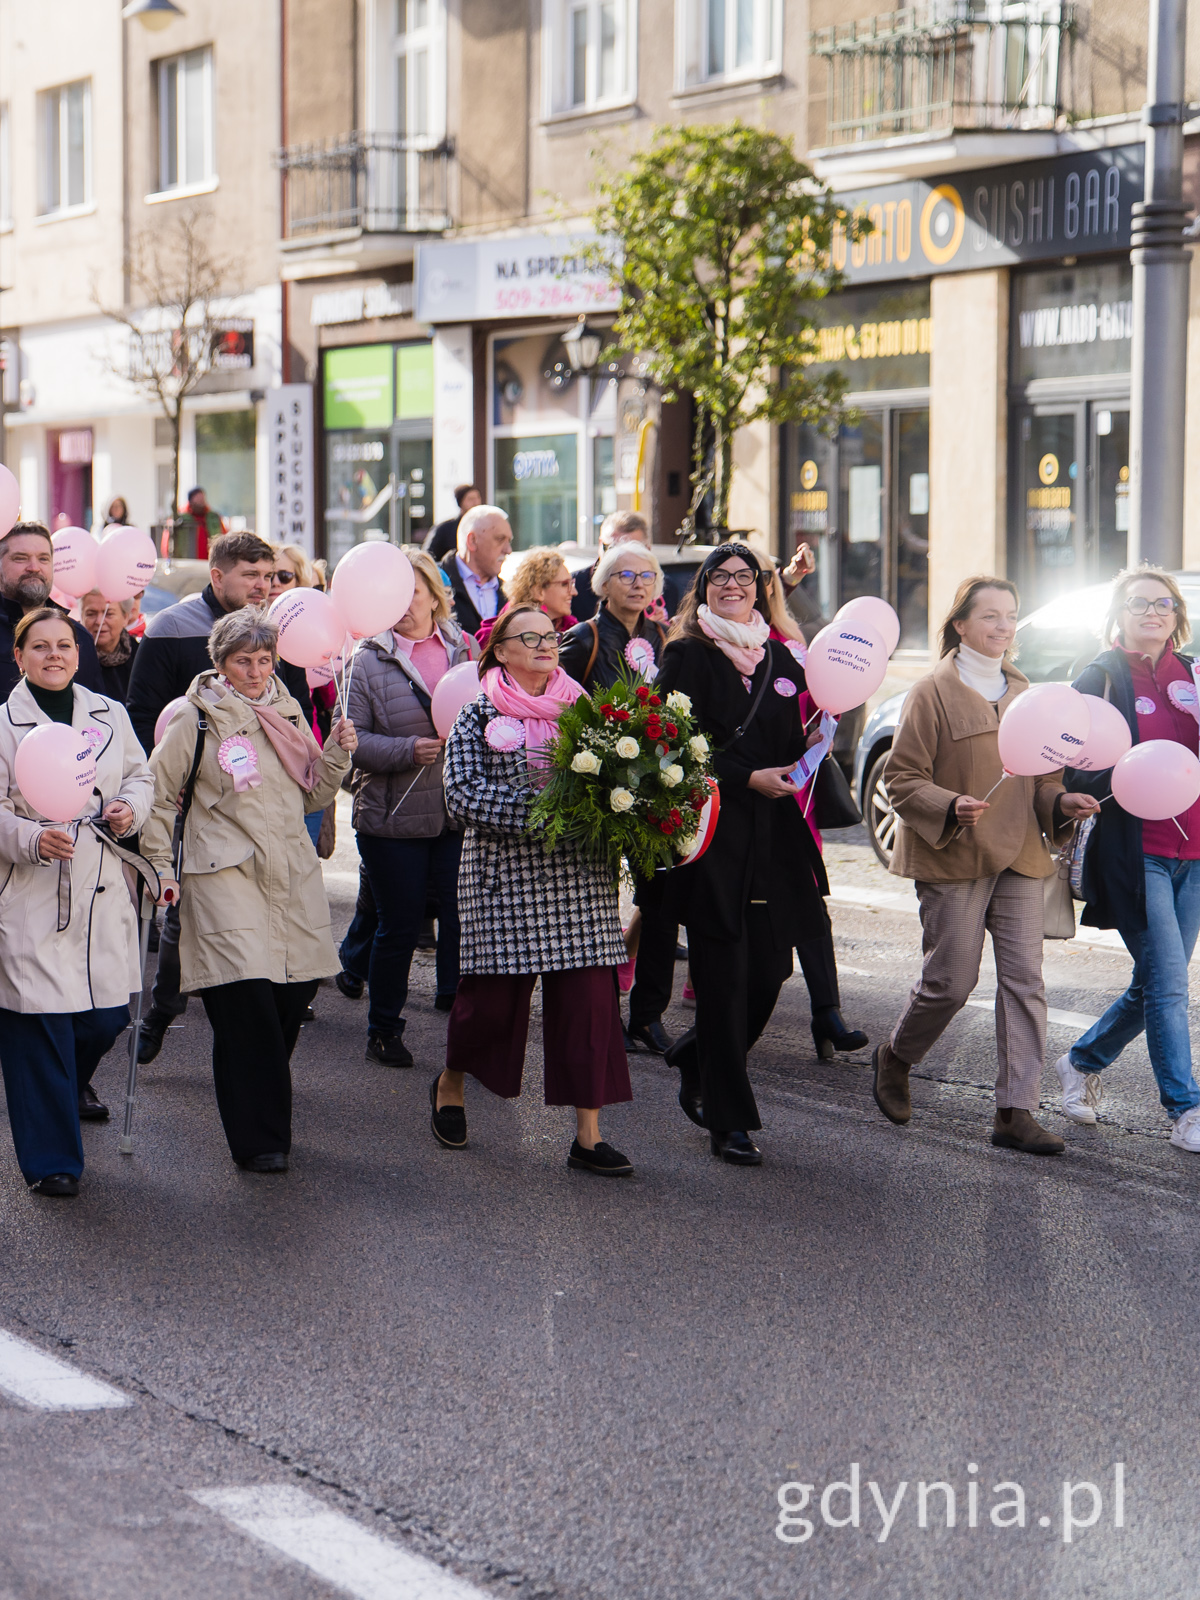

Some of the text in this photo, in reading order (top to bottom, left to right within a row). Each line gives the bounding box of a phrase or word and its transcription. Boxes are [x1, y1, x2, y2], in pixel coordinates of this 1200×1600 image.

[973, 175, 1055, 252] SUSHI
[1064, 165, 1120, 240] BAR
[496, 261, 519, 279] NA
[840, 632, 874, 648] GDYNIA
[827, 648, 853, 658] miasto
